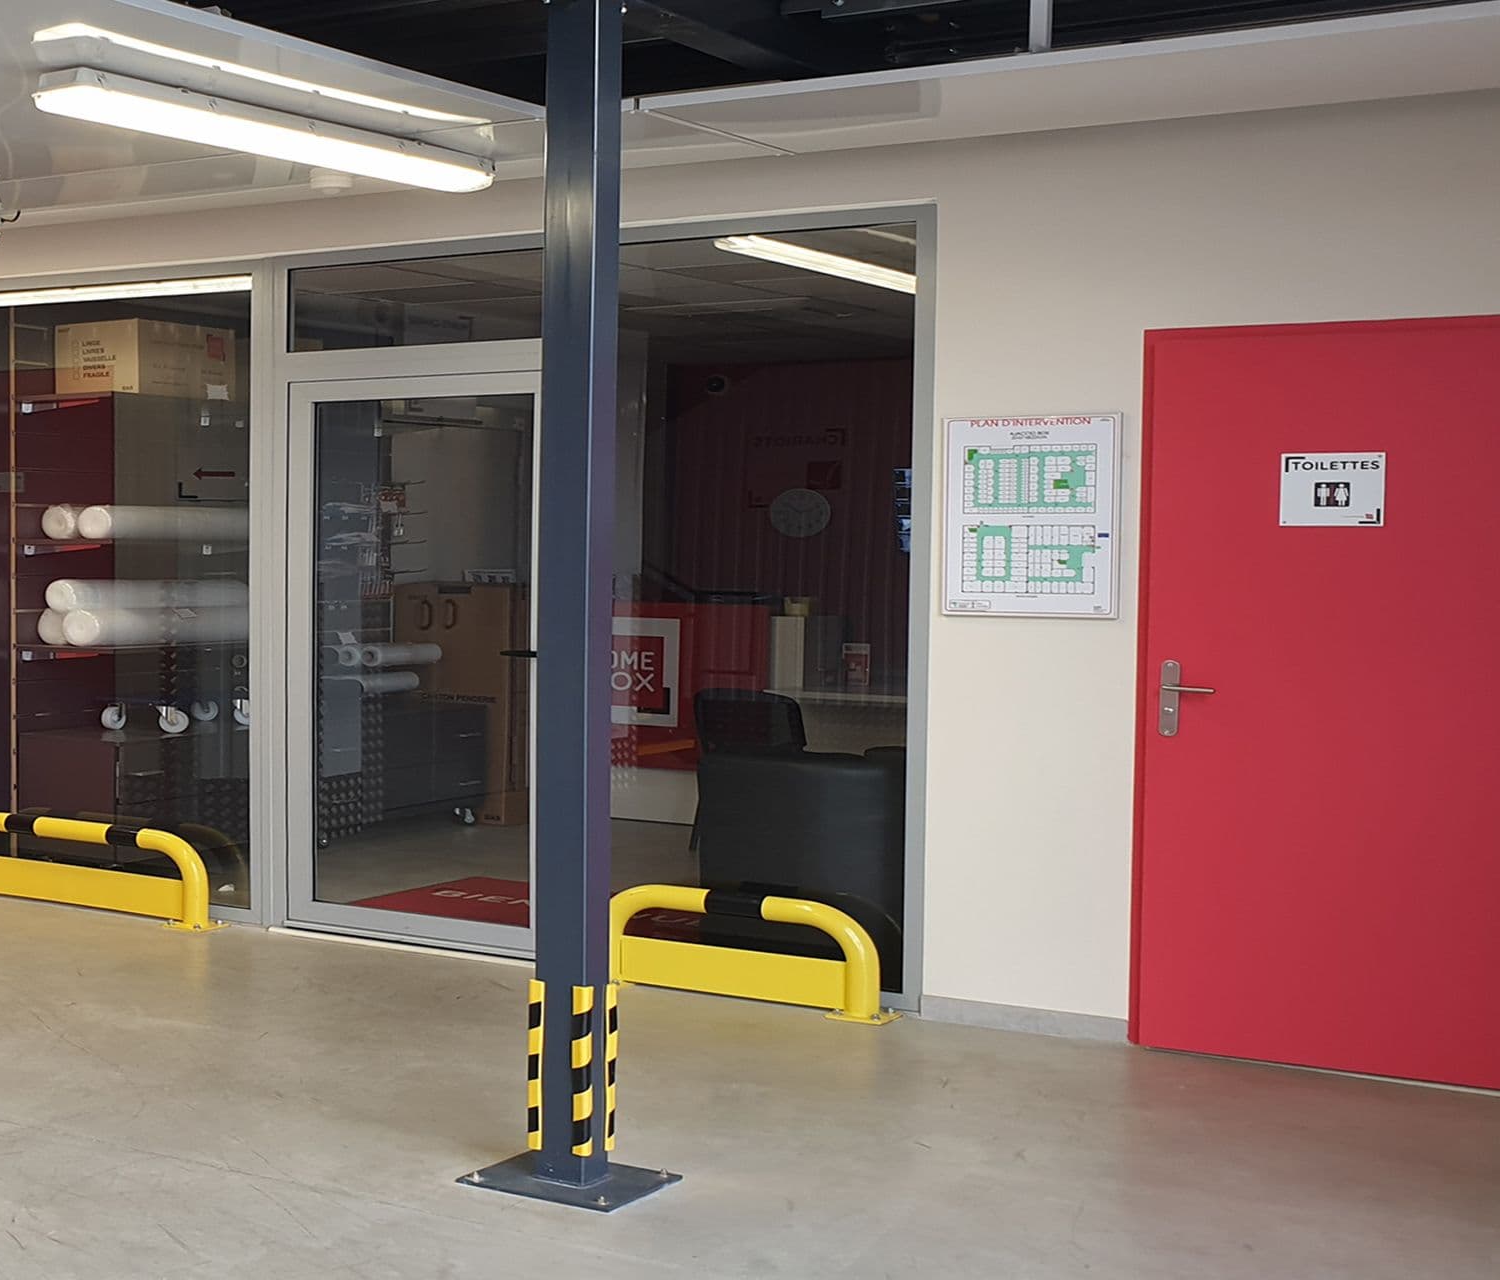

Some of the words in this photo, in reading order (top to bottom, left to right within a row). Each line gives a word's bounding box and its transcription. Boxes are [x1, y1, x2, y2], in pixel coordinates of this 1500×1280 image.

[970, 419, 999, 428] PLAN
[1291, 460, 1380, 471] TOILETTES
[611, 672, 654, 693] OX
